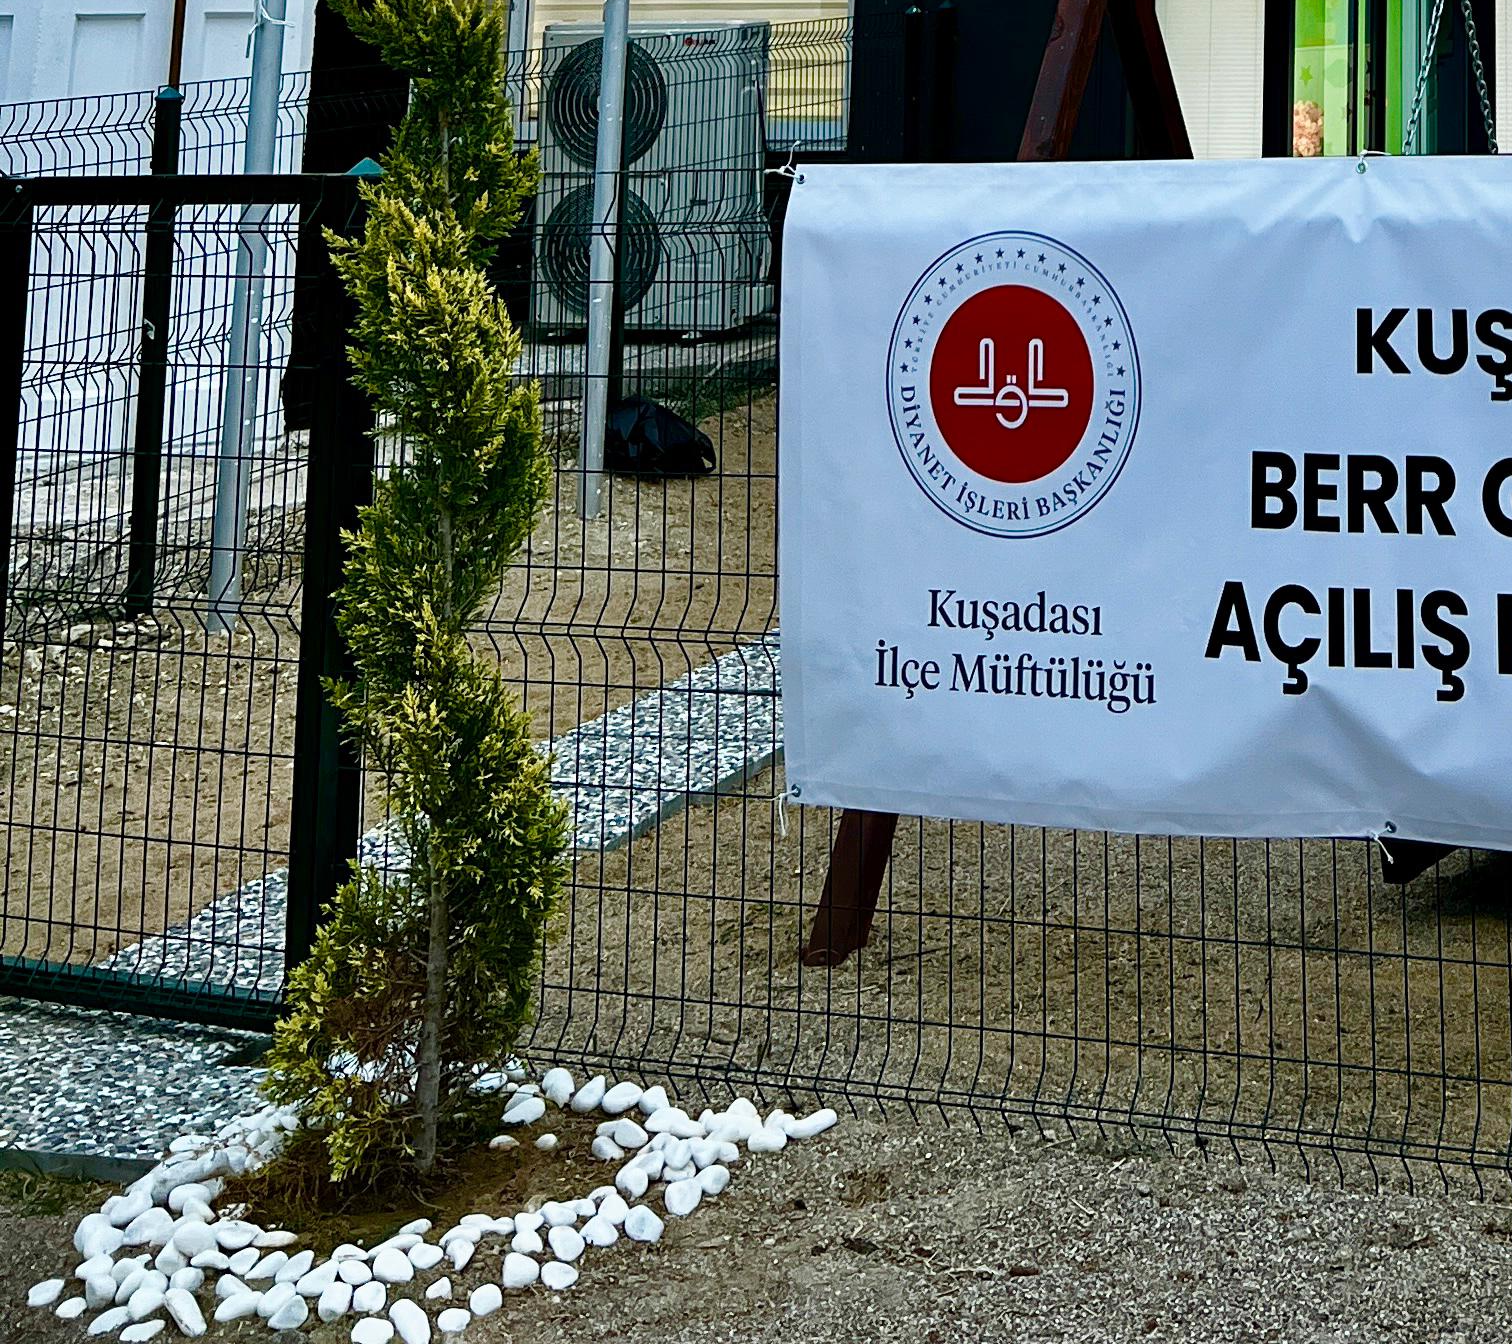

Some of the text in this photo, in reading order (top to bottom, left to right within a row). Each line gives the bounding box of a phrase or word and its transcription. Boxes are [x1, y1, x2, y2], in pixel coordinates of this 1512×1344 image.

[900, 385, 1127, 521] DİYANET İŞLERİ BAŞKANLIĞI
[1250, 450, 1458, 537] BERR
[927, 589, 1103, 640] Kuşadası
[1204, 580, 1471, 702] AÇILIŞ
[873, 639, 1158, 715] İlçe Müftülüğü
